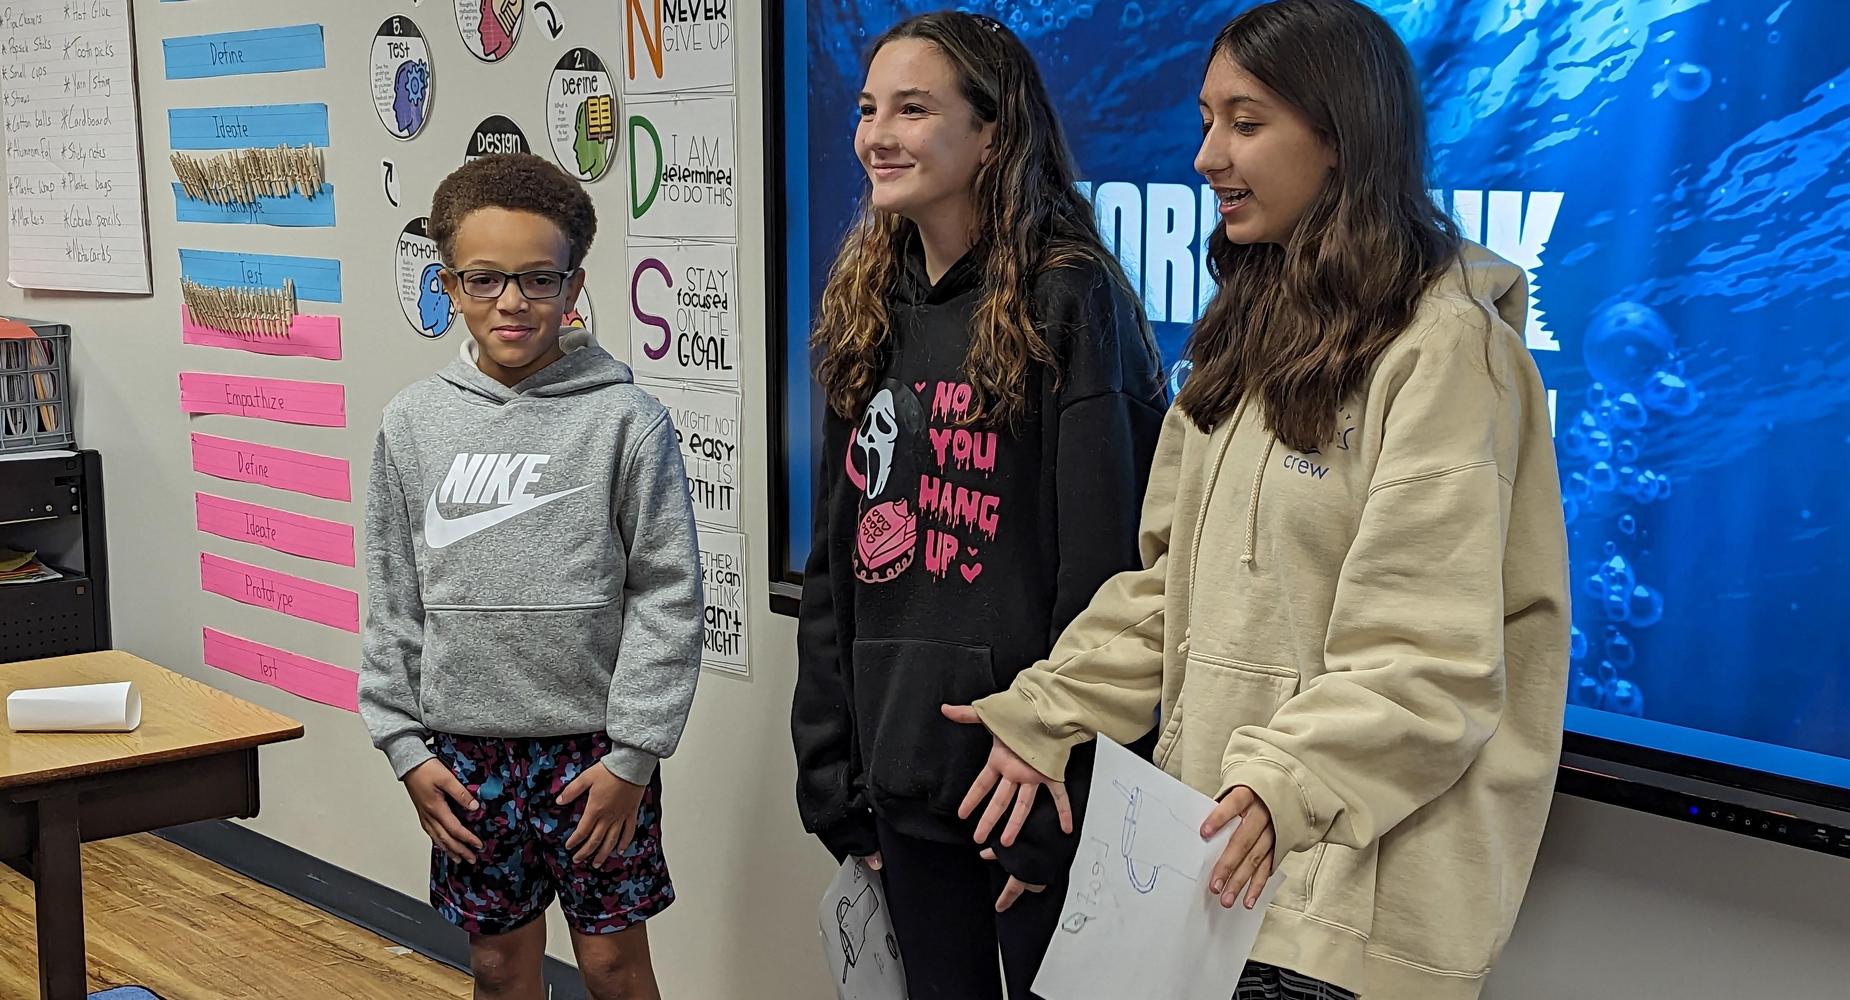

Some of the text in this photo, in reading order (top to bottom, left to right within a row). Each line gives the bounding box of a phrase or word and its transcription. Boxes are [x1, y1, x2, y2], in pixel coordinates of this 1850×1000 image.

[663, 0, 727, 24] NEVER
[392, 18, 403, 35] 5.
[626, 0, 663, 80] N
[662, 23, 730, 51] GIVE UP
[209, 42, 244, 66] Define
[387, 42, 410, 59] Test
[573, 50, 585, 69] 2.
[561, 75, 599, 96] Define
[68, 104, 111, 129] Cardboard
[212, 115, 249, 139] Ideate
[477, 131, 521, 154] Design
[672, 134, 719, 167] I AM
[629, 115, 663, 219] D
[662, 164, 731, 186] determined
[661, 184, 733, 207] TO DO THIS
[400, 240, 442, 262] Protot
[1073, 181, 1217, 324] OR
[240, 260, 264, 285] Test
[686, 267, 728, 292] STAY
[631, 258, 673, 360] S
[677, 288, 728, 311] focused
[677, 308, 729, 336] ON THE
[677, 331, 733, 371] GOAL
[225, 384, 285, 416] Empathize
[931, 381, 972, 423] NO
[676, 409, 736, 437] MIGHT NOT
[237, 451, 269, 478] Define
[929, 428, 997, 479] YOU
[1283, 455, 1330, 480] crew
[438, 453, 551, 505] NIKE
[696, 457, 710, 479] IT
[717, 462, 734, 485] IS
[687, 477, 735, 511] RTH IT
[918, 475, 1000, 542] HANG
[244, 512, 277, 541] Ideate
[925, 529, 959, 583] UP
[716, 570, 741, 586] can
[245, 574, 293, 614] Prototype
[703, 582, 741, 609] THINK
[704, 605, 742, 632] an't
[704, 628, 742, 656] RIGHT
[256, 652, 279, 680] Test
